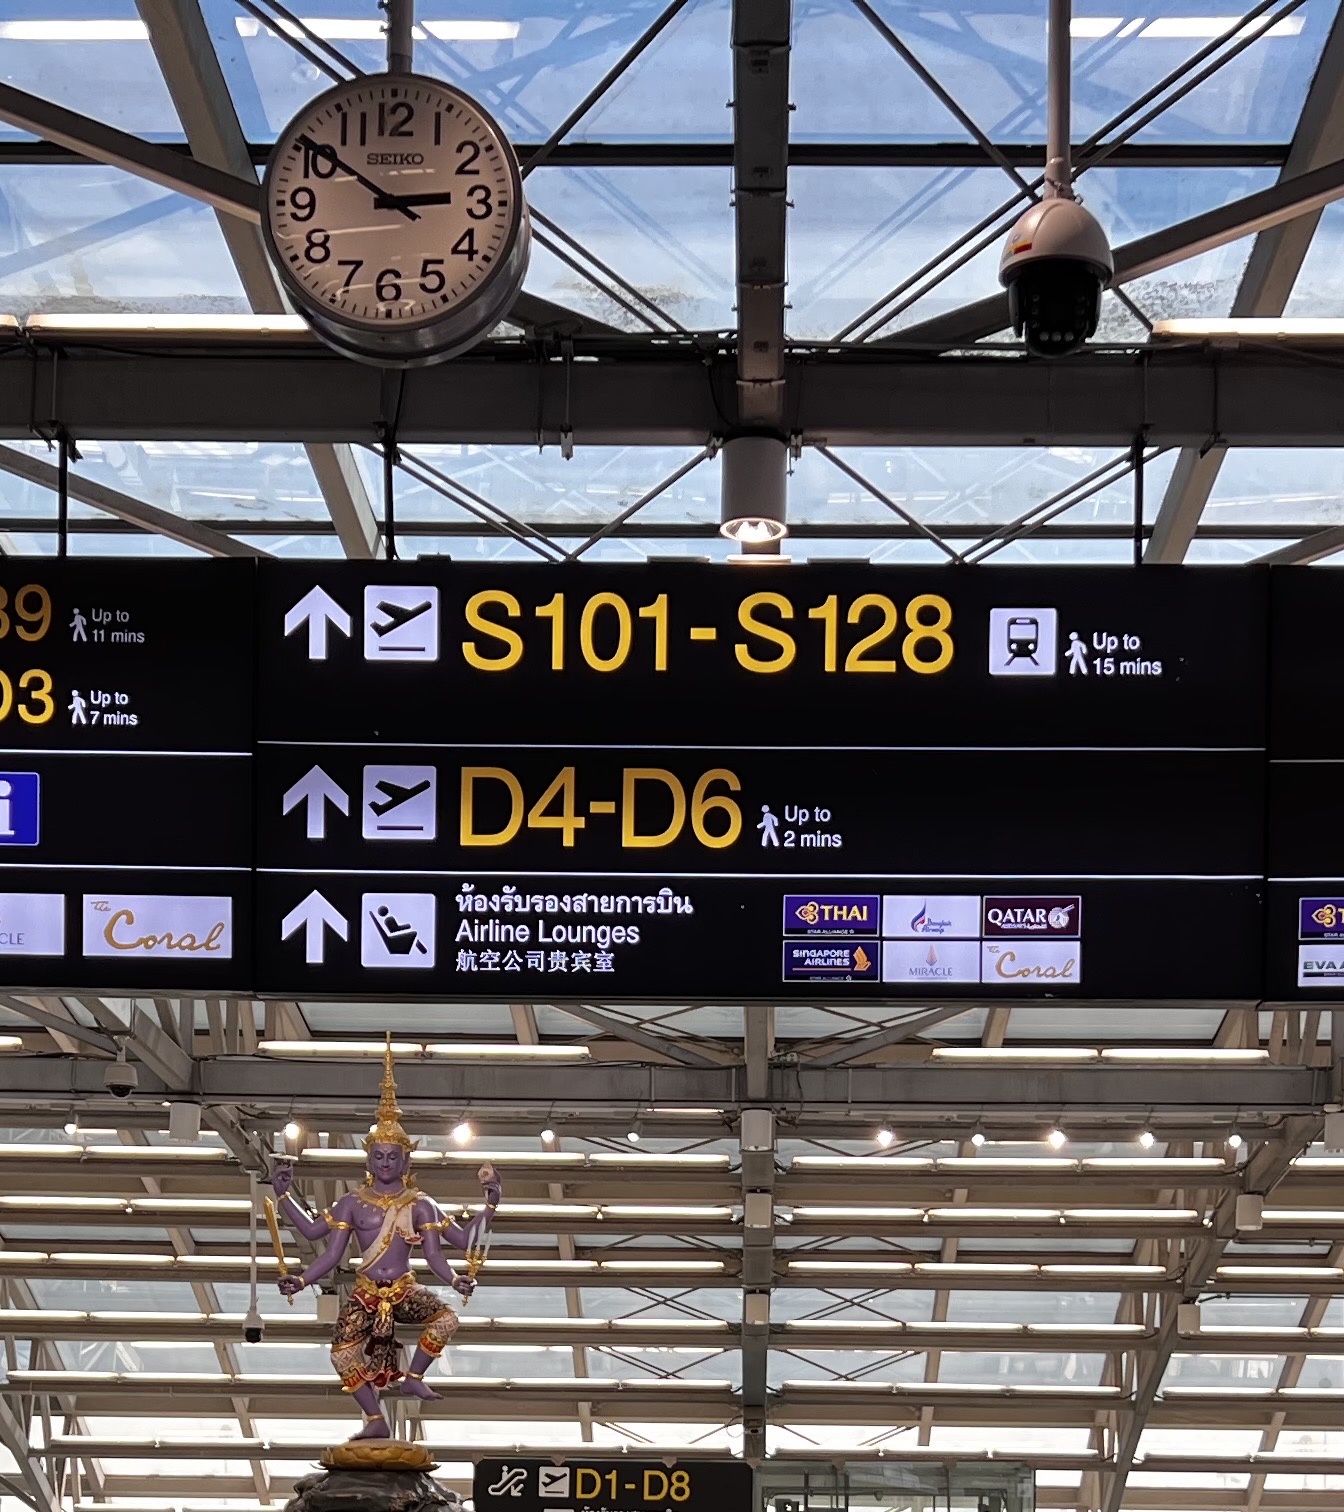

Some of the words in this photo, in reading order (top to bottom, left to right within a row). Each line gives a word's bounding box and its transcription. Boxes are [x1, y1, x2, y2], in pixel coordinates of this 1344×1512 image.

[341, 112, 366, 146] 11
[378, 102, 414, 137] 12
[434, 112, 441, 146] 1
[367, 153, 424, 166] SEIKO
[455, 140, 480, 175] 2
[290, 186, 316, 222] 9
[466, 184, 492, 220] 3
[304, 228, 331, 263] 8
[451, 228, 478, 261] 4
[338, 260, 363, 294] 7
[376, 269, 402, 302] 6
[419, 259, 446, 294] 5
[92, 608, 111, 624] Up
[116, 610, 129, 622] to
[93, 629, 104, 642] 11
[111, 632, 144, 643] mins
[462, 590, 953, 674] S101-S128
[1093, 632, 1118, 653] Up
[1123, 634, 1140, 650] to
[1093, 658, 1115, 675] 15
[1120, 658, 1162, 675] mins
[91, 690, 111, 707] Up
[114, 692, 128, 704] to
[90, 711, 100, 724] 7
[104, 711, 138, 725] mins
[460, 767, 742, 848] D4-D6
[785, 805, 809, 825] Up
[814, 807, 831, 822] to
[784, 830, 795, 847] 2
[801, 830, 842, 847] mins
[455, 883, 693, 913] ห้องรับรองสายการบิน
[820, 904, 868, 921] THAI
[103, 909, 225, 951] Coral
[987, 908, 1047, 926] QATAR
[455, 919, 530, 942] Airline
[539, 920, 640, 949] Lounges
[456, 949, 614, 972] 航空公司贵宾室
[909, 967, 953, 976] MIRACLE
[995, 951, 1076, 979] Coral
[1303, 961, 1336, 970] EVA
[576, 1468, 691, 1501] D1-D8
